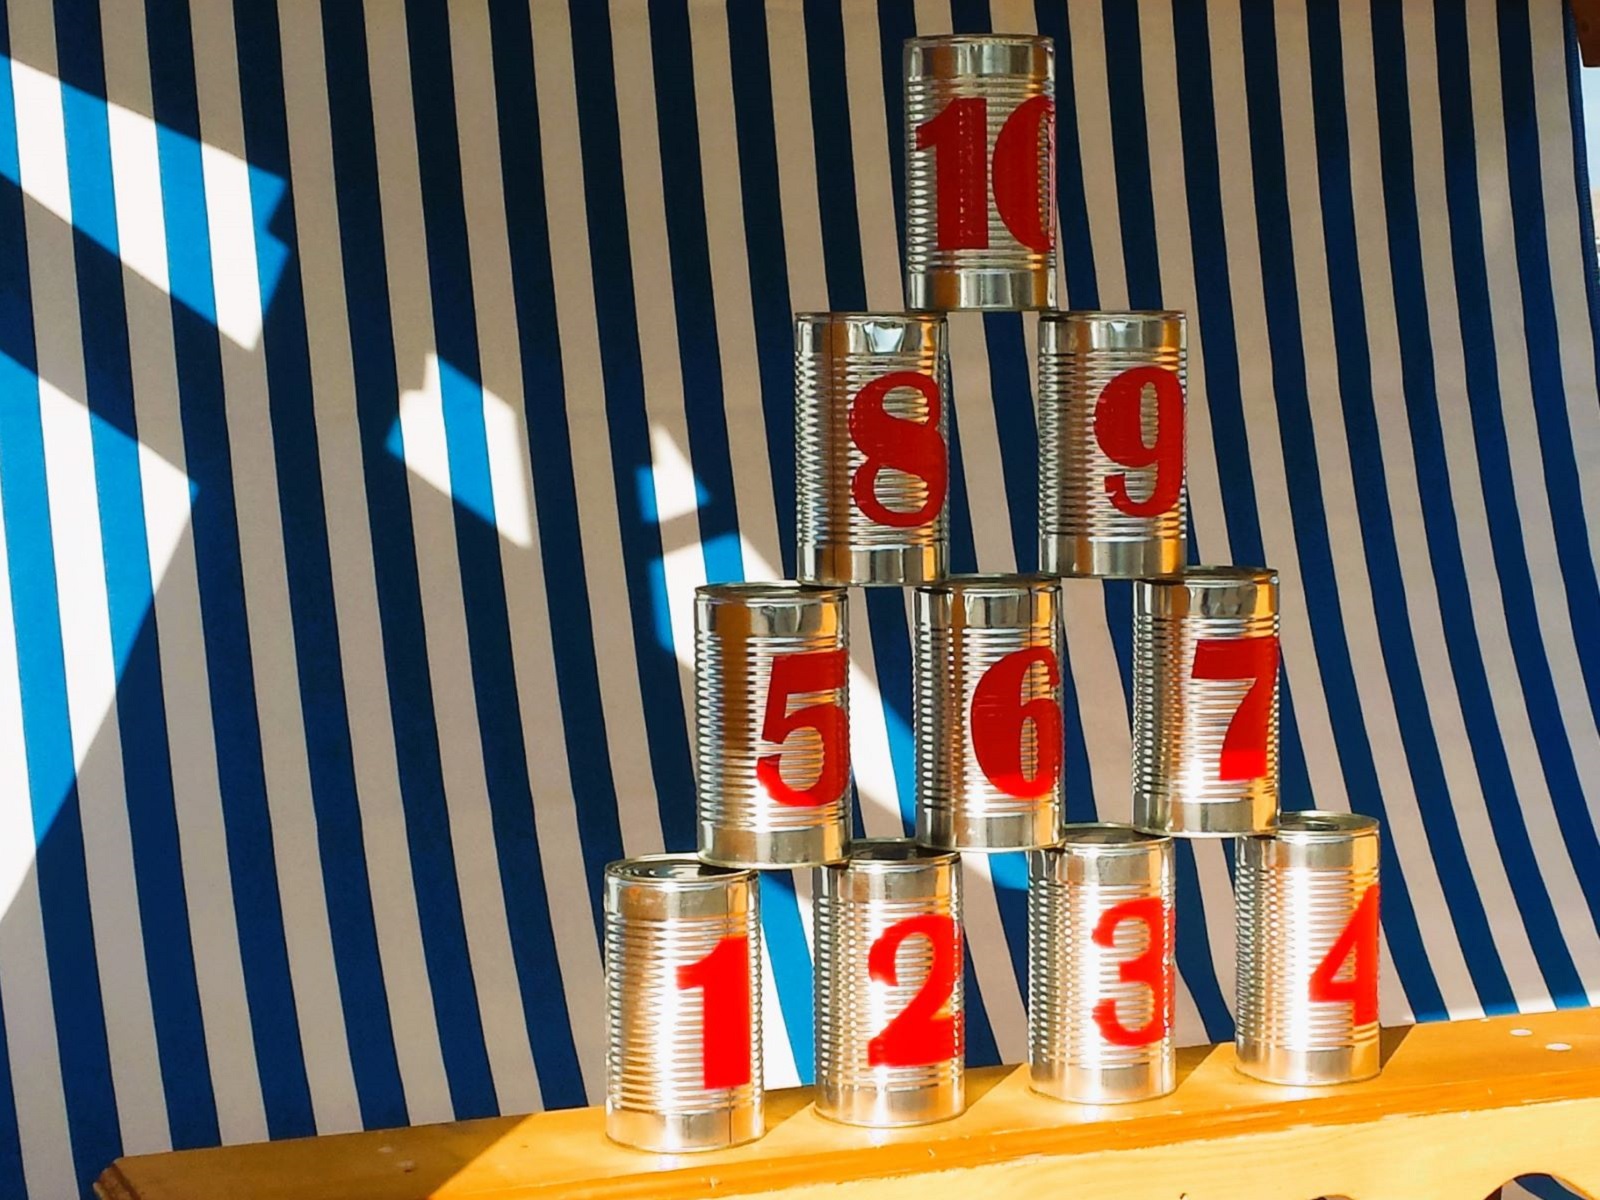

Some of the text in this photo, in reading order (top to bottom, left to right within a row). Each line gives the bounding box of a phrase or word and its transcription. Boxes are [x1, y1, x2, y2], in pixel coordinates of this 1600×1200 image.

[917, 96, 1056, 254] 10
[848, 371, 946, 527] 8
[1097, 366, 1187, 518] 9
[756, 650, 849, 808] 5
[971, 645, 1063, 798] 6
[1192, 637, 1279, 781] 7
[678, 930, 751, 1089] 1
[868, 913, 965, 1067] 2
[1092, 896, 1175, 1047] 3
[1309, 884, 1379, 1026] 4
